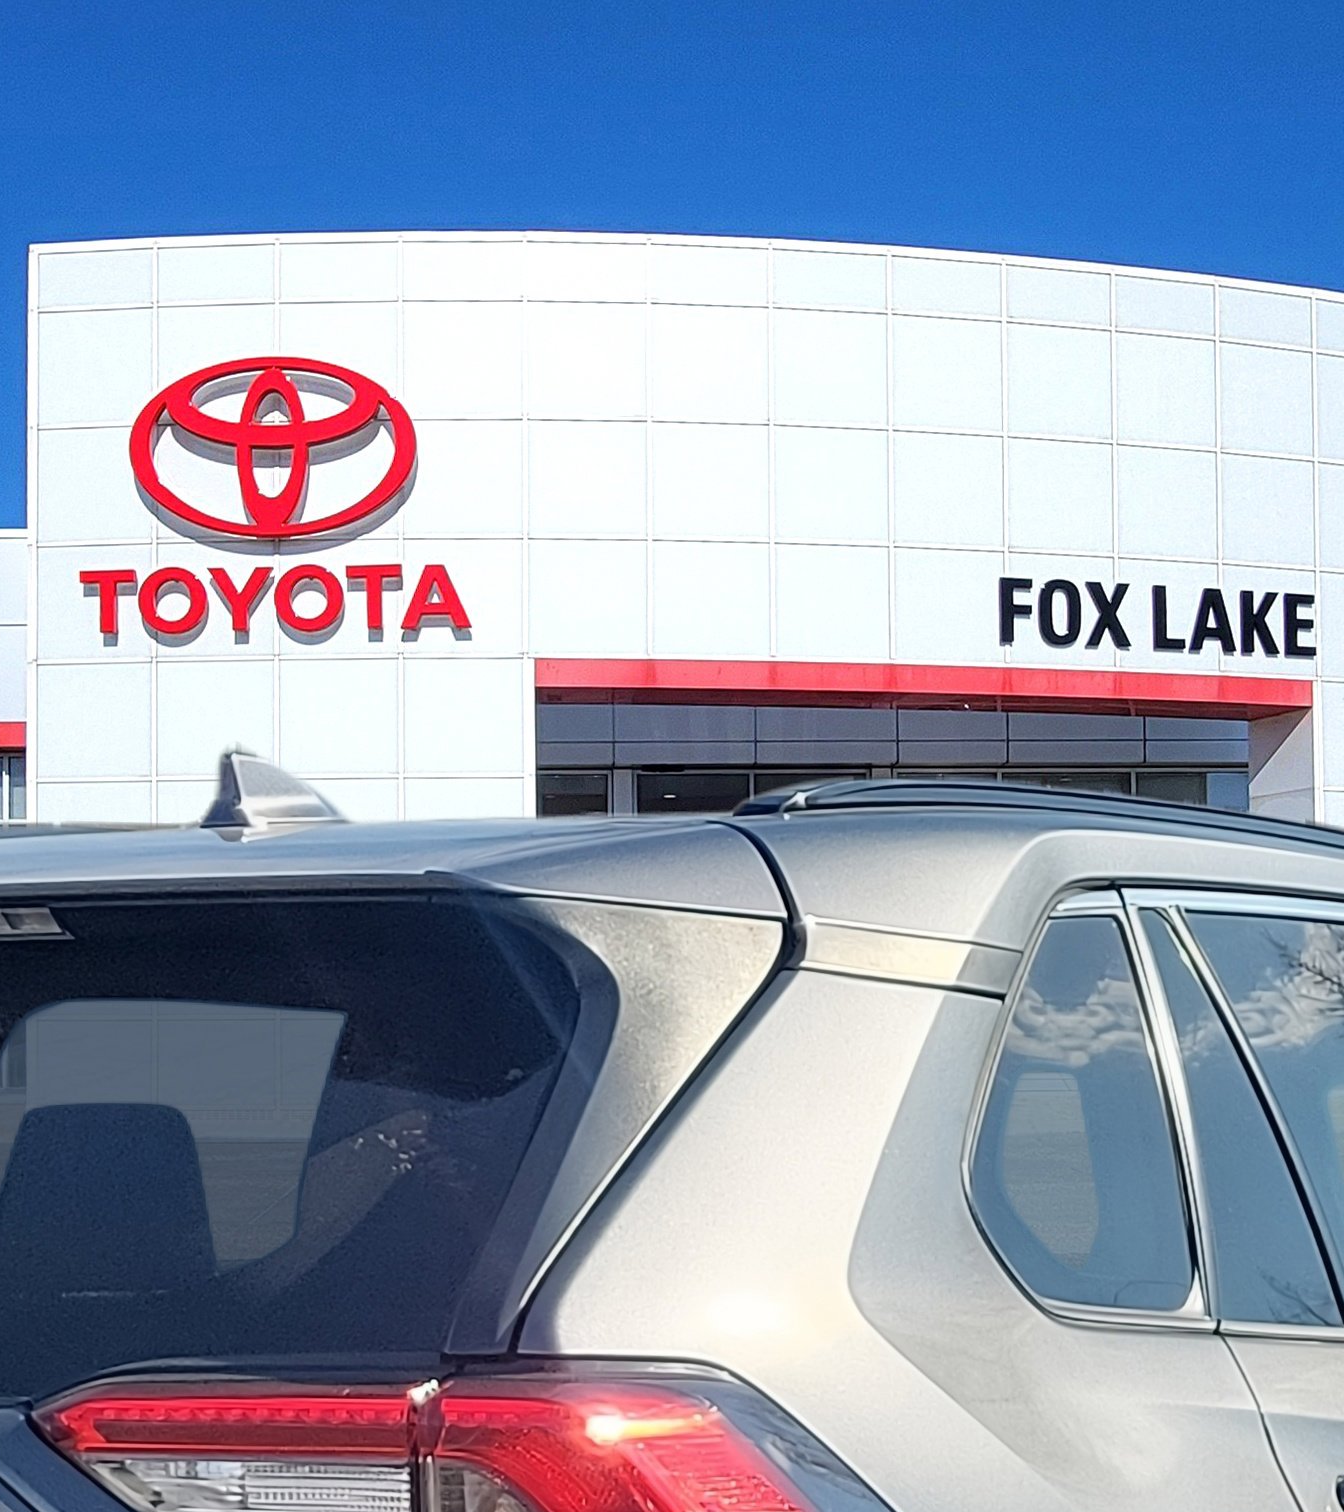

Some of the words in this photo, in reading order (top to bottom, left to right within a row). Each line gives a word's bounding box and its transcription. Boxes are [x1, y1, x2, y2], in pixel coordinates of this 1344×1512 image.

[79, 564, 472, 635] TOYOTA
[999, 577, 1132, 649] FOX
[1152, 585, 1317, 657] LAKE
